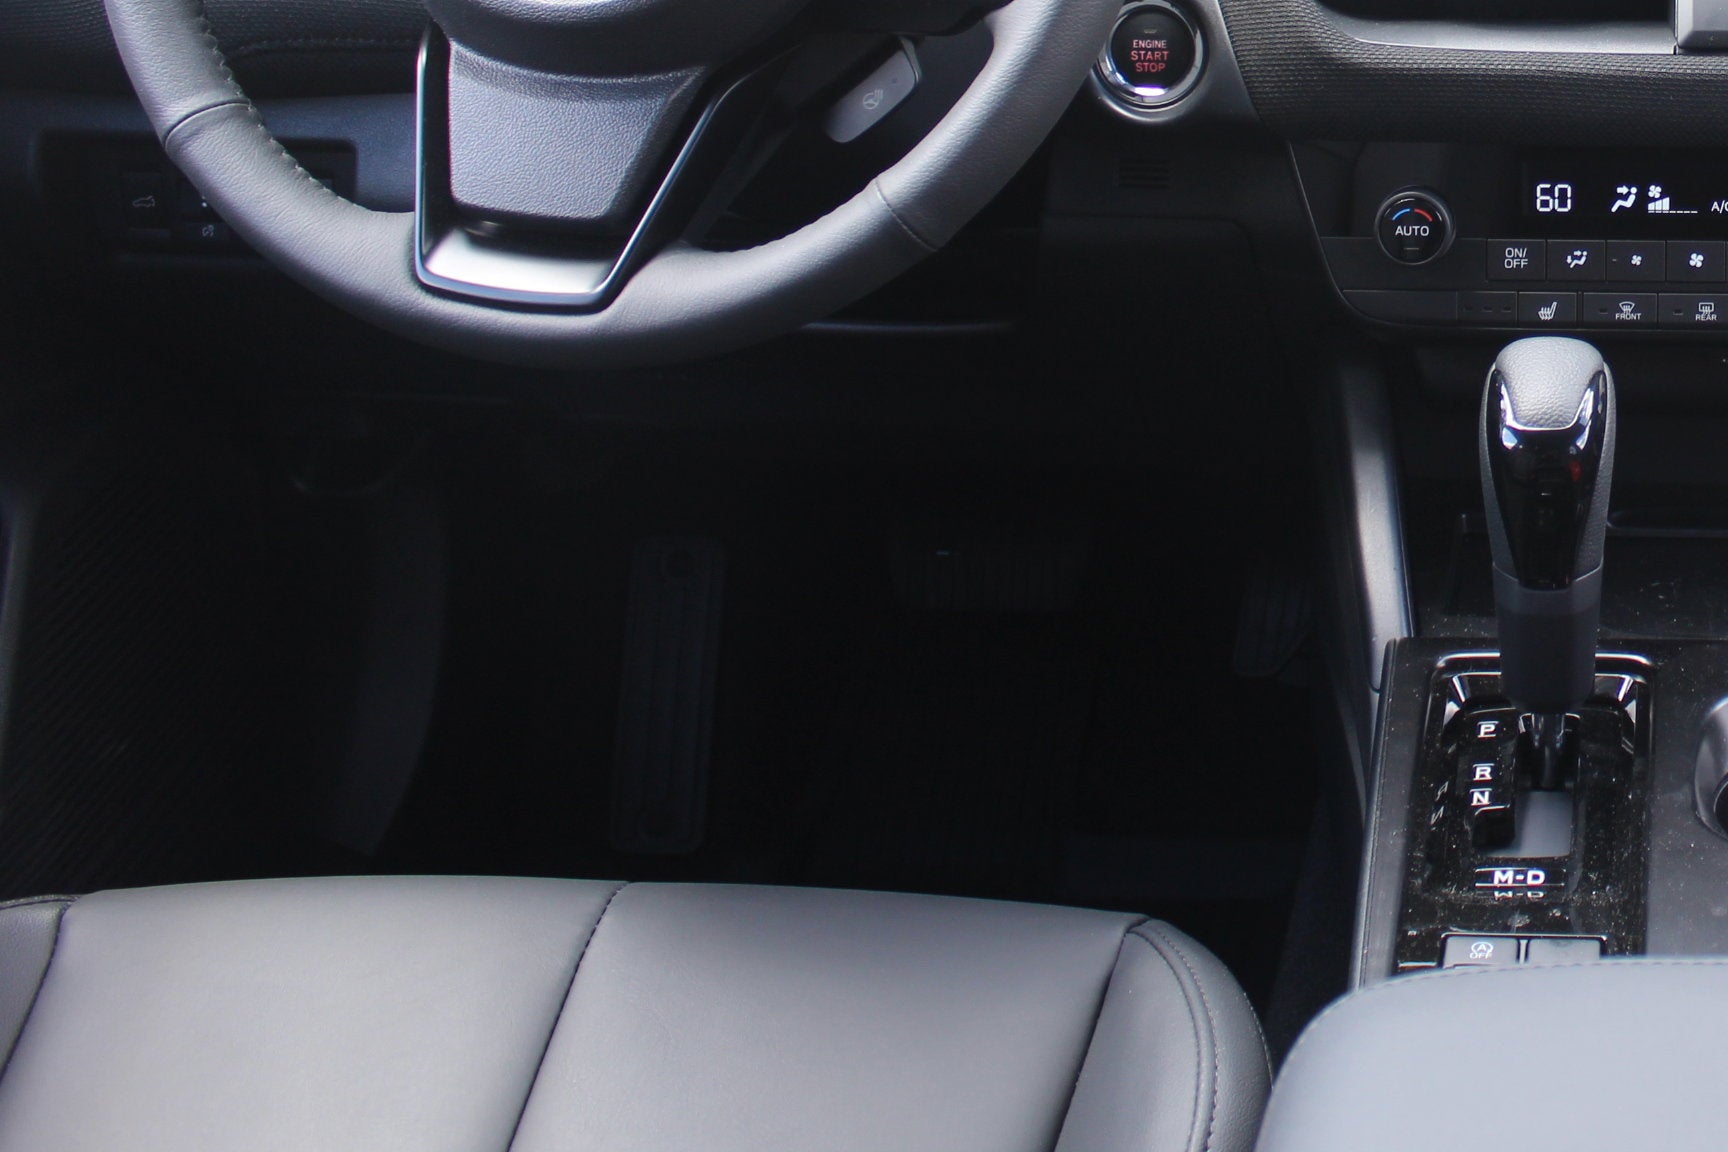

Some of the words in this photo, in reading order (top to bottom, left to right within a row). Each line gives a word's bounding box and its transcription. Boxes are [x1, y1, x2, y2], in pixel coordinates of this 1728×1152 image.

[1132, 40, 1168, 49] ENGINE
[1130, 50, 1169, 61] START
[1136, 62, 1166, 73] STOP
[1536, 184, 1572, 212] 60
[1394, 226, 1430, 237] AUTO
[1505, 248, 1527, 258] ON/
[1504, 258, 1528, 269] OFF
[1478, 724, 1496, 736] P
[1475, 766, 1492, 780] R
[1472, 791, 1490, 805] N
[1493, 870, 1546, 886] M-D
